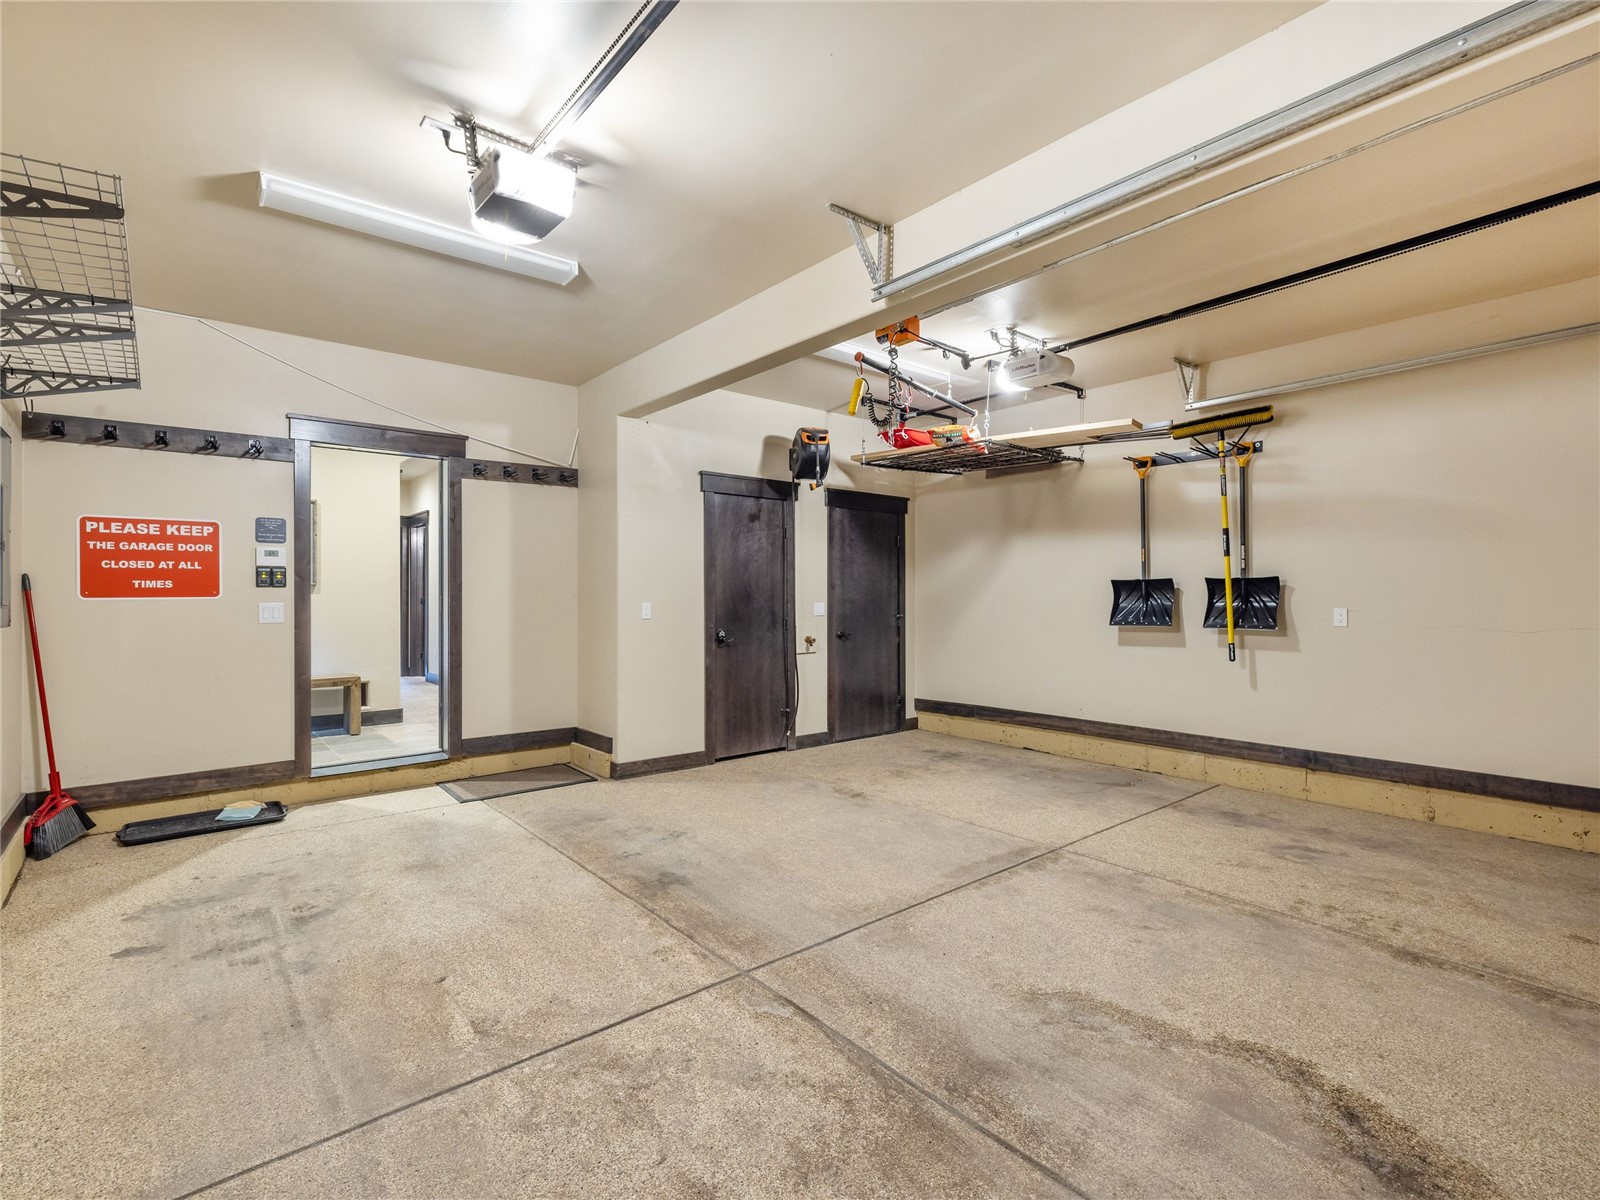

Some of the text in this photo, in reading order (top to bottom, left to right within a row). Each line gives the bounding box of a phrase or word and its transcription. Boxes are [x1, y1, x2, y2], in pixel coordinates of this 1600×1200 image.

[85, 521, 214, 537] PLEASE KEEP
[86, 541, 213, 552] THE GARAGE DOOR
[101, 560, 202, 570] CLOSED AT ALL
[132, 580, 173, 588] TIMES
